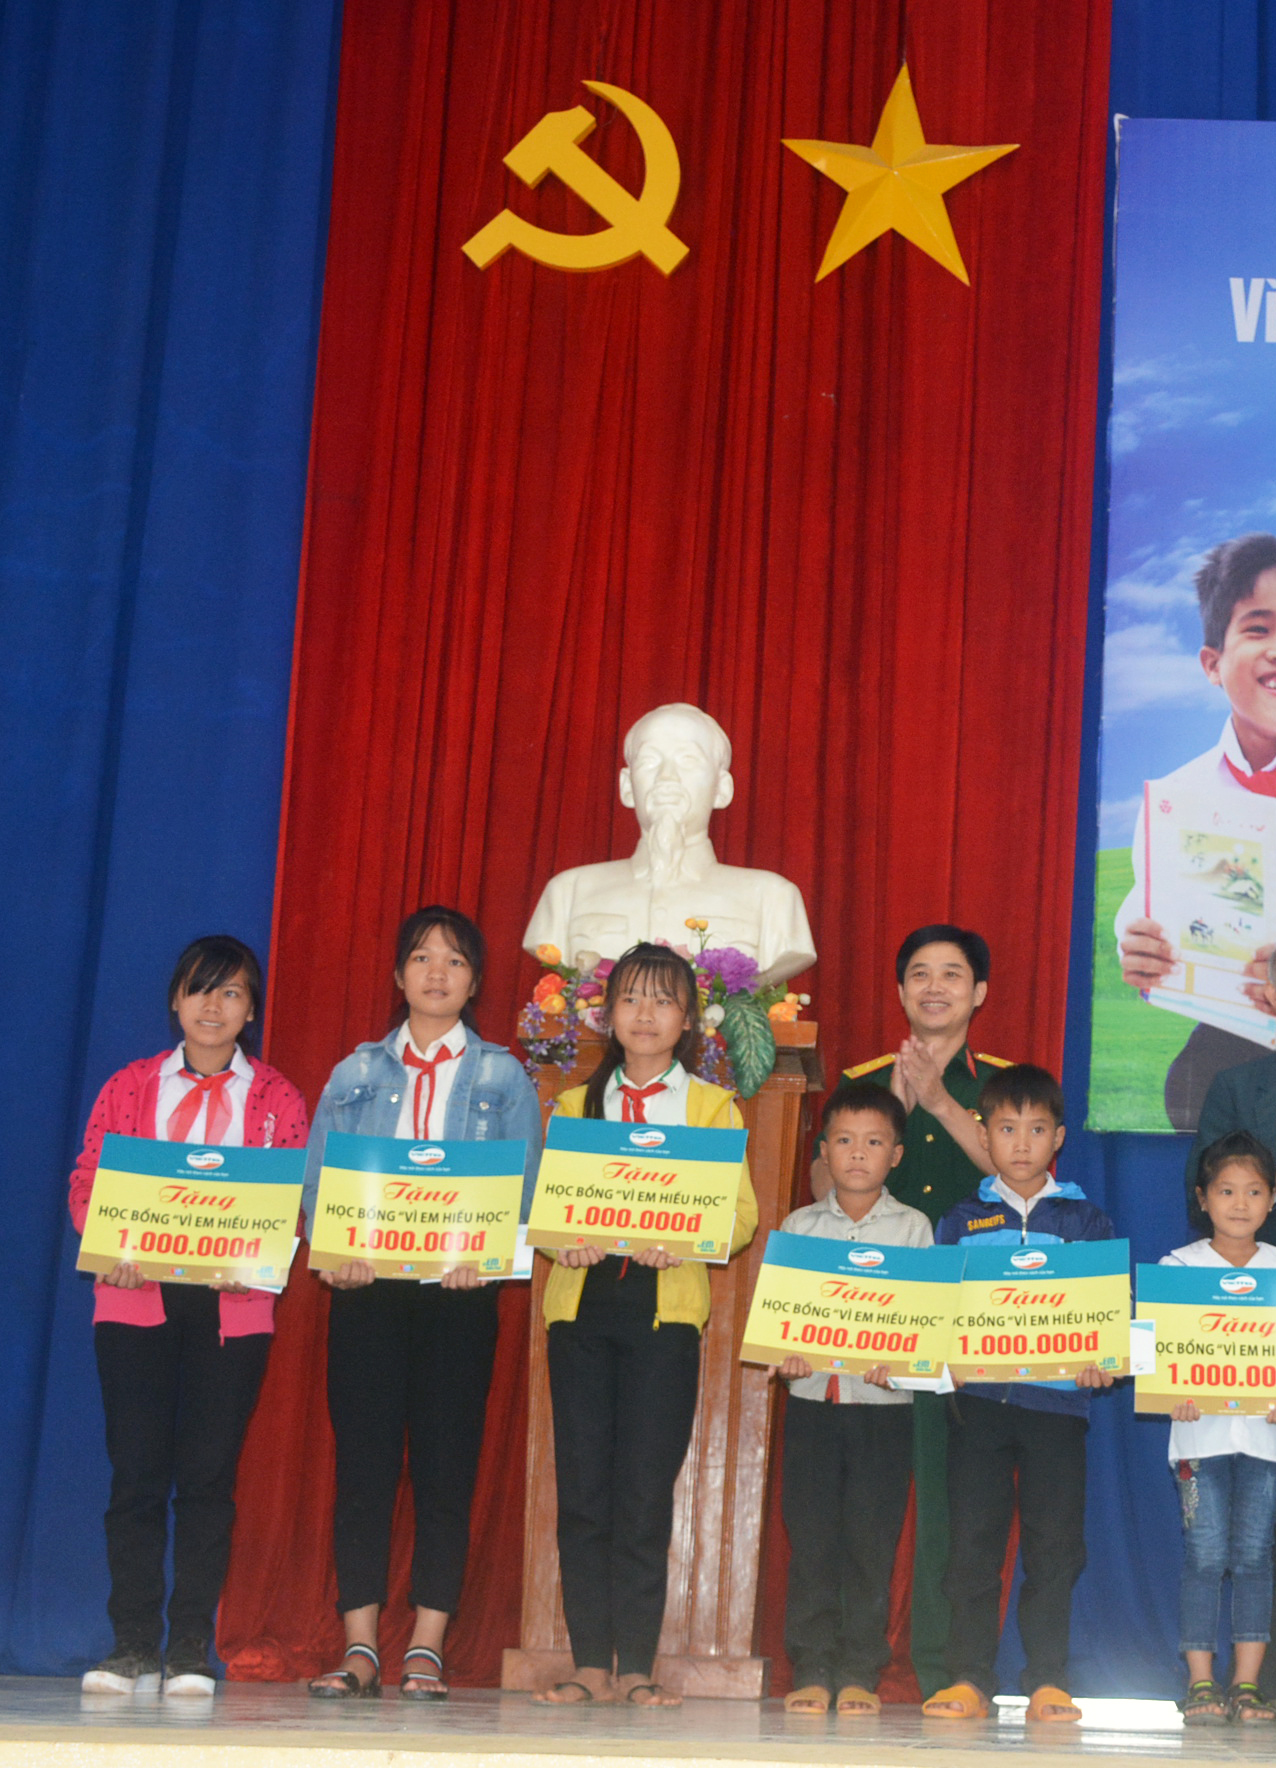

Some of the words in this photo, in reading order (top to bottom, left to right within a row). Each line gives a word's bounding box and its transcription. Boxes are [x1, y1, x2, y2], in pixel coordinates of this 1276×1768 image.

[603, 1162, 678, 1186] Tặng
[160, 1185, 236, 1211] Tặng
[383, 1182, 460, 1205] Tặng
[545, 1184, 573, 1198] HỌC
[638, 1192, 656, 1202] EM
[660, 1190, 690, 1204] HIẾU
[99, 1205, 128, 1221] HỌC
[195, 1216, 214, 1228] EM
[218, 1216, 249, 1229] HIẾU
[326, 1204, 354, 1218] HỌC
[421, 1212, 439, 1223] EM
[443, 1209, 472, 1223] HIẾU
[564, 1204, 702, 1232] 1.000.000đ
[118, 1228, 262, 1258] 1.000.000đ
[346, 1226, 486, 1251] 1.000.000đ
[820, 1281, 896, 1306] Tặng
[990, 1288, 1066, 1308] Tặng
[762, 1299, 790, 1312] HỌC
[855, 1312, 873, 1322] EM
[877, 1310, 907, 1325] HIẾU
[1031, 1314, 1049, 1326] EM
[1053, 1310, 1083, 1325] HIẾU
[780, 1321, 919, 1352] 1.000.000đ
[1199, 1313, 1276, 1337] Tặng
[958, 1331, 1099, 1355] 1.000.000đ
[1156, 1342, 1173, 1358] ỌC
[1240, 1345, 1258, 1356] EM
